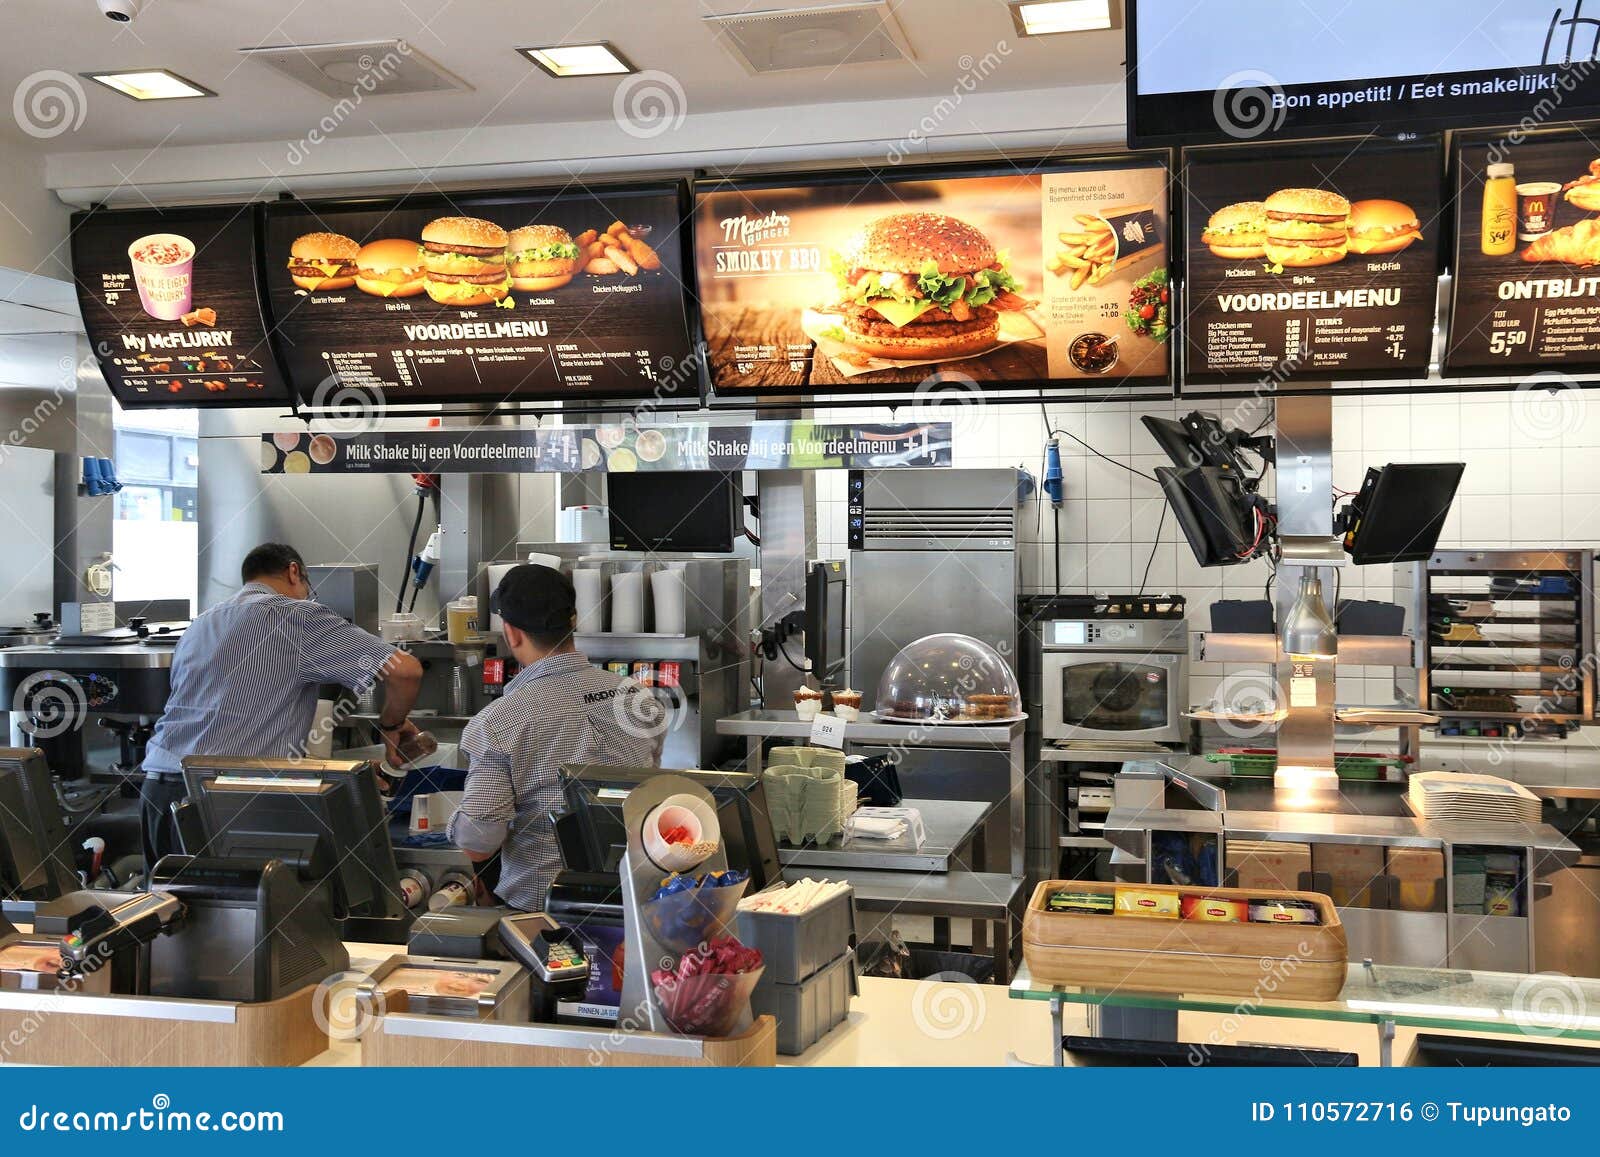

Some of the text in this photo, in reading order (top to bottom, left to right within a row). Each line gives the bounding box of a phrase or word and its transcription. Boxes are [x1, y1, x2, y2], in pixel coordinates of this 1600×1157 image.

[1272, 93, 1310, 109] Bon
[1317, 85, 1392, 108] appetit!
[1410, 84, 1444, 100] Eet
[1450, 73, 1557, 97] smakelijk!
[720, 210, 790, 246] Maestro
[747, 227, 790, 246] BURGER
[716, 248, 820, 272] SMOKEY BBQ
[1367, 263, 1401, 272] Filet-O-Fish
[1225, 269, 1256, 277] McChicken
[1293, 276, 1315, 285] Big Mac
[1498, 277, 1600, 300] ONTBIJT
[1218, 288, 1401, 312] VOORDEELMENU
[403, 320, 548, 341] VOORDEELMENU
[122, 331, 232, 352] My McFLURRY
[346, 444, 371, 459] Milk
[373, 444, 409, 460] Shake
[411, 444, 427, 463] bij
[429, 446, 450, 459] een
[453, 443, 540, 460] Voordeelmenu
[677, 440, 706, 457] Milk
[708, 440, 748, 457] Shake
[751, 440, 767, 459] bij
[770, 442, 794, 456] een
[797, 439, 897, 455] Voordeelmenu
